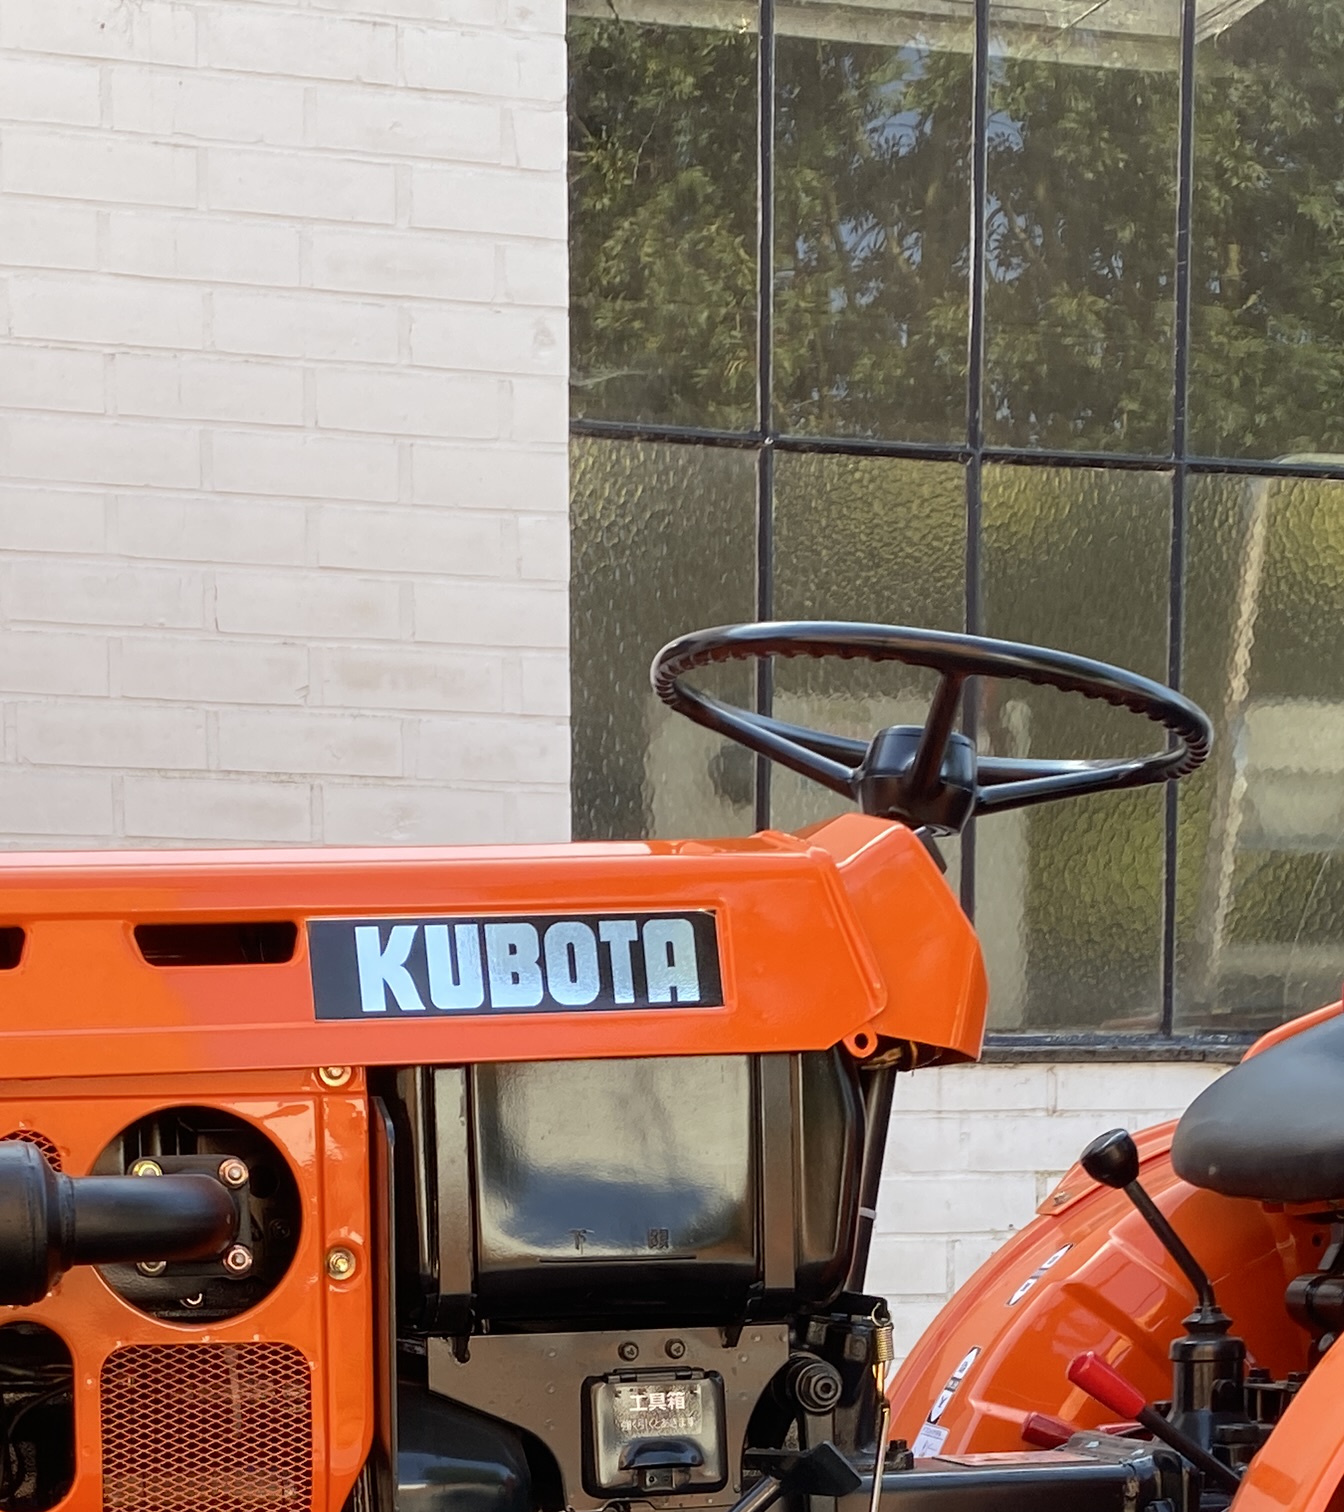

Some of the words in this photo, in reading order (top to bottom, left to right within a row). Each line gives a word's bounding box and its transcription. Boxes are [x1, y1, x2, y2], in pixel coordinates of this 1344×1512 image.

[354, 917, 701, 1013] KUBOTA
[629, 1391, 686, 1412] 工具箱
